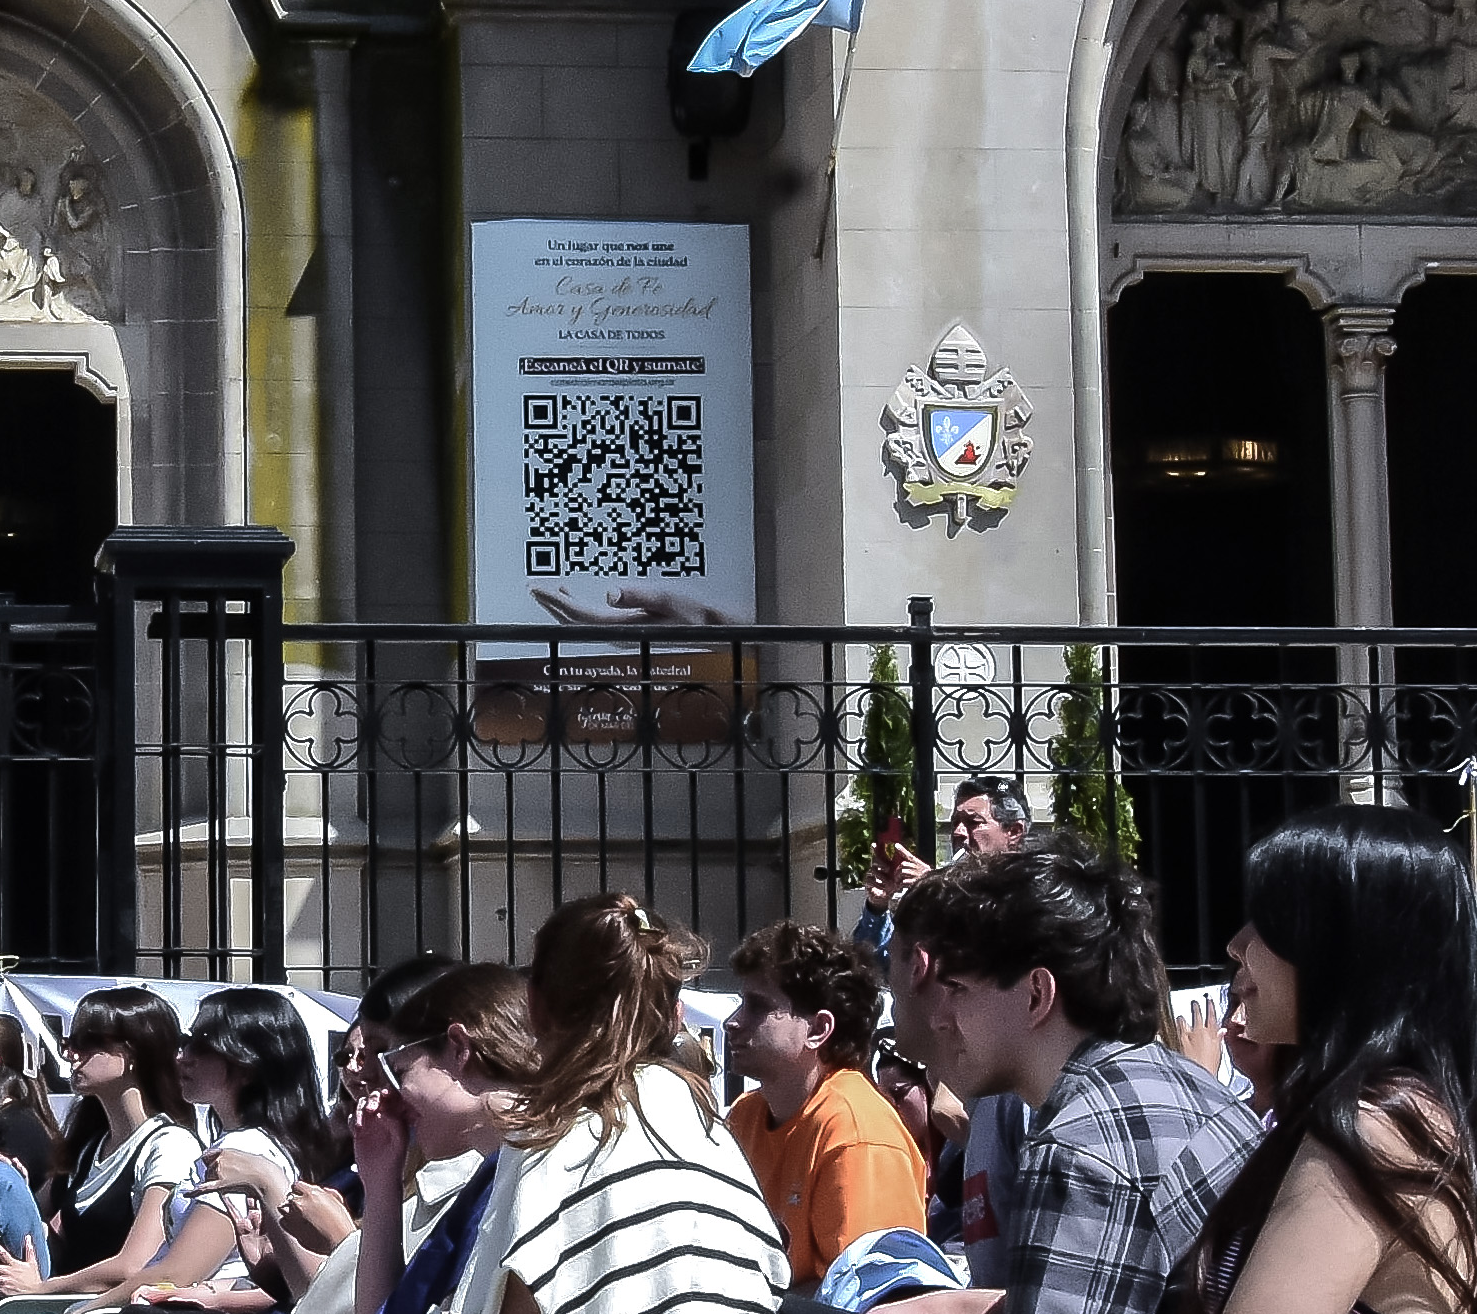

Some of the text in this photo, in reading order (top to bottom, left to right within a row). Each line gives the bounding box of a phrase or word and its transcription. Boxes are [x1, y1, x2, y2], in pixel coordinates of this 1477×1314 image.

[568, 240, 599, 254] lugar
[602, 242, 623, 254] que
[566, 256, 614, 267] corazón
[616, 256, 631, 267] de
[634, 256, 645, 267] la
[646, 256, 688, 267] ciudad
[555, 275, 604, 296] Casa
[611, 276, 631, 296] de
[506, 296, 719, 326] Amor y Generosidad
[558, 330, 666, 340] LA CASA DE TODOS
[589, 359, 603, 370] el
[606, 359, 630, 373] QR
[633, 362, 642, 373] y
[644, 359, 704, 371] sumate!
[543, 665, 569, 676] Cn
[641, 664, 691, 676] atedral
